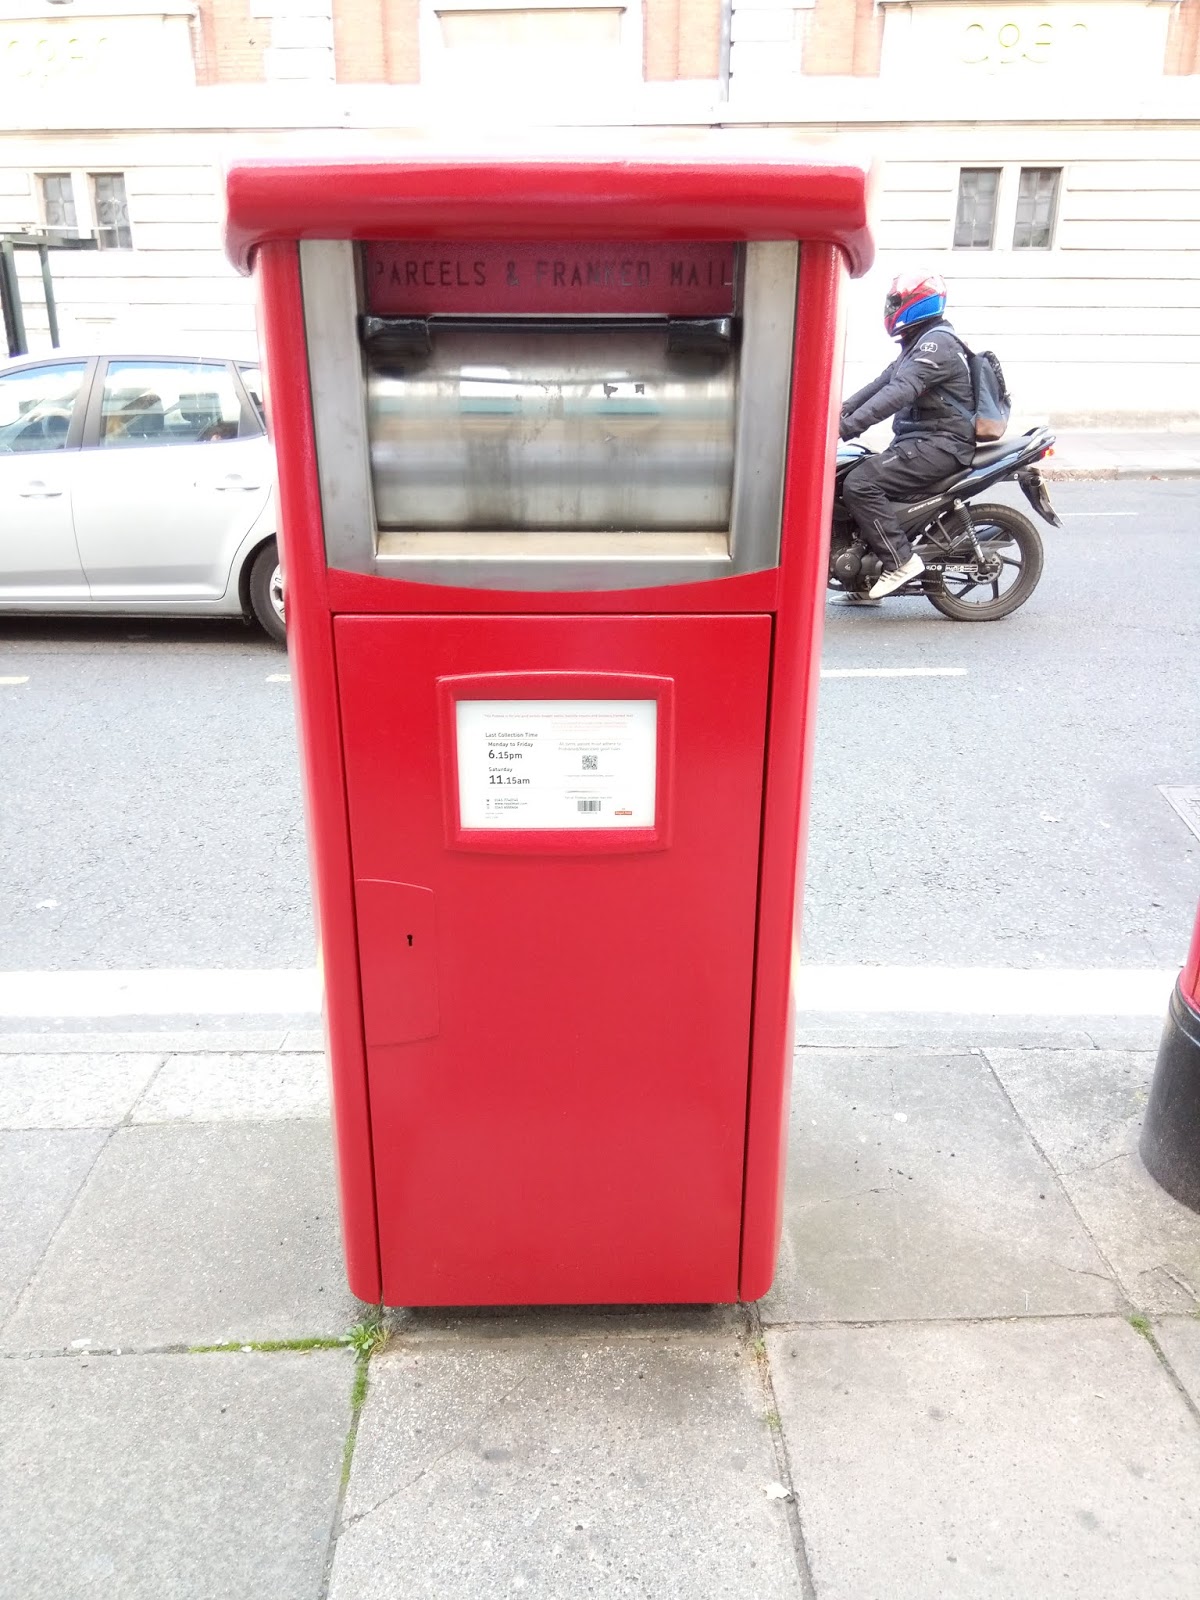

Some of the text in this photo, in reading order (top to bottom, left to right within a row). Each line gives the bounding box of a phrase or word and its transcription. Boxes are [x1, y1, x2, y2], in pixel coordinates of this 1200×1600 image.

[375, 259, 732, 287] PARCELS & FRANKED MAIL
[488, 749, 523, 760] 6.15pm
[489, 774, 531, 785] 11.15am
